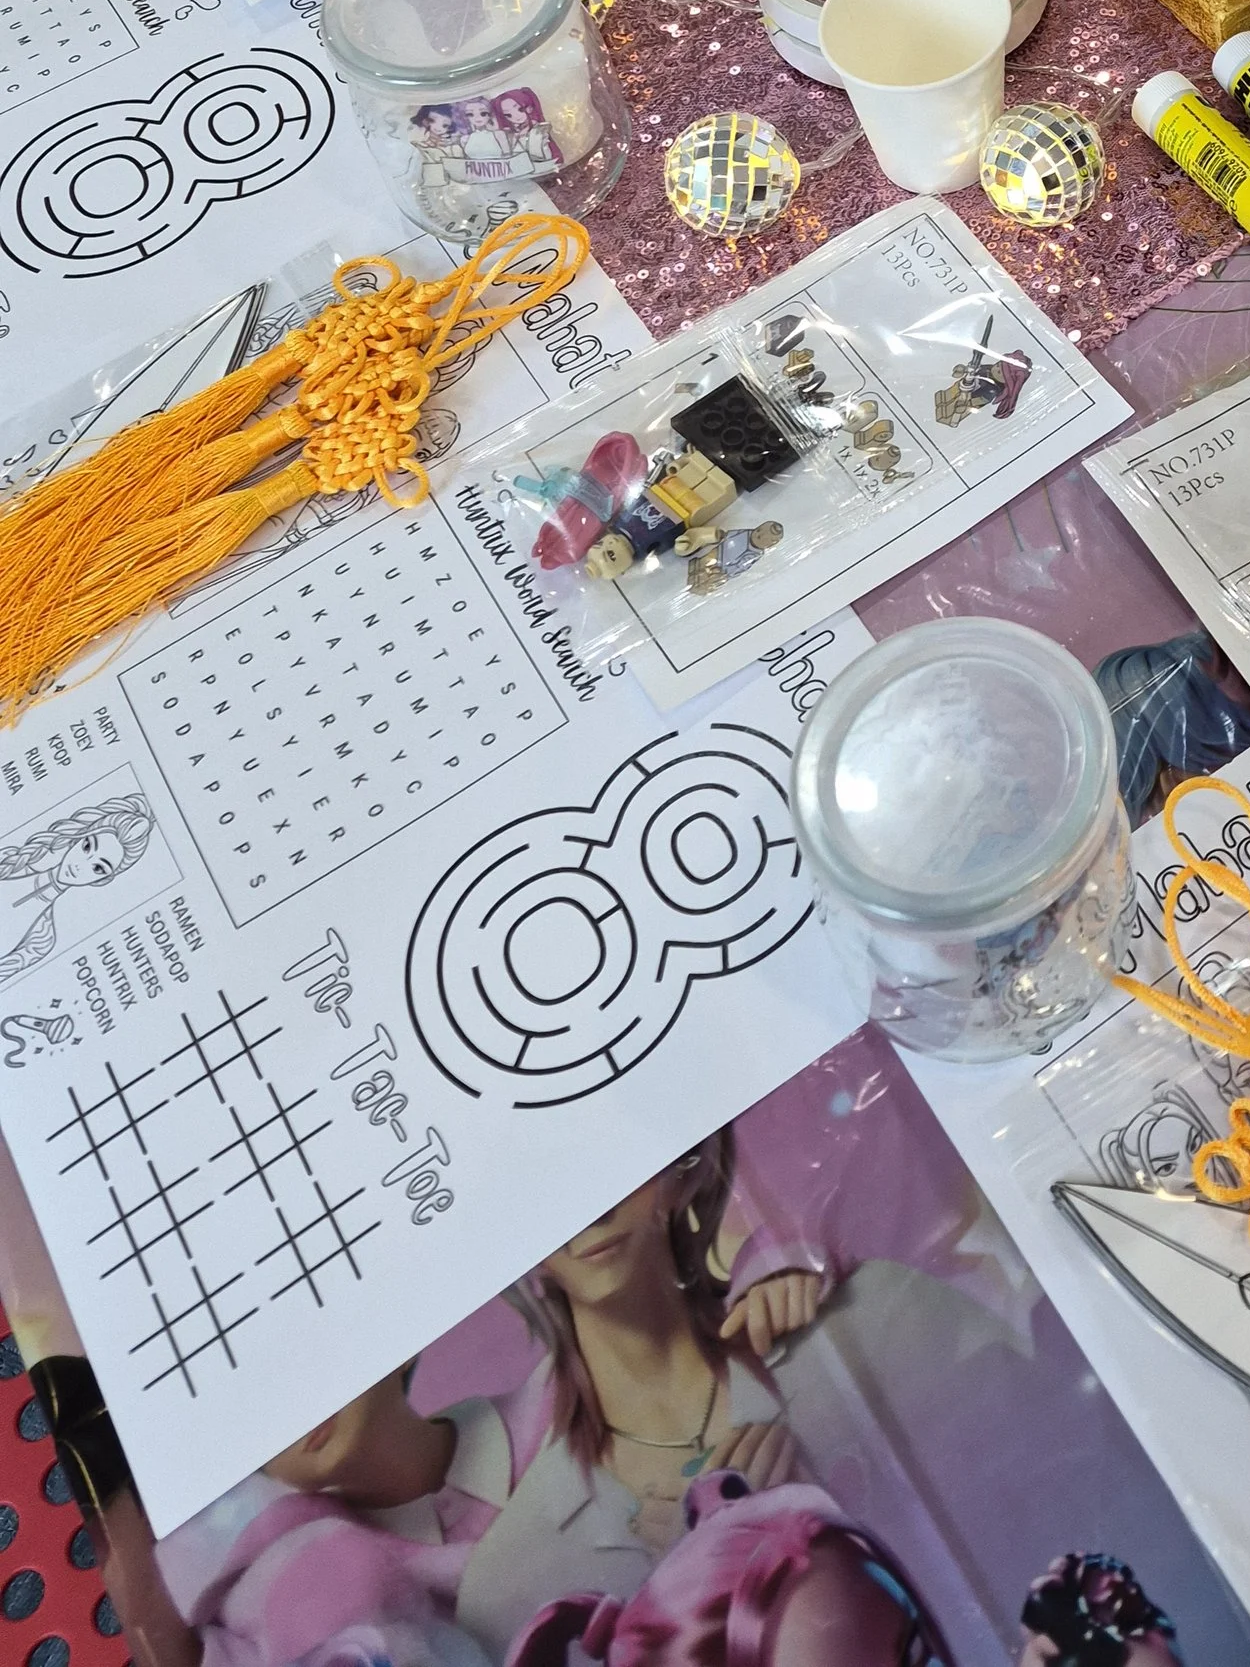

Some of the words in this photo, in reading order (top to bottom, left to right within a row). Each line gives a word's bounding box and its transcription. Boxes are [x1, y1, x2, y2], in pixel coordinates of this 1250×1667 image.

[465, 161, 513, 179] HUNTRIX
[881, 244, 920, 287] 13Pcs
[902, 227, 968, 294] NO.731P
[1148, 428, 1236, 485] NO.731P
[1168, 471, 1225, 507] 13Pcs
[455, 483, 516, 566] Huntrix
[504, 563, 559, 629] Word
[541, 625, 604, 702] Search
[47, 733, 73, 768] KPOP
[69, 719, 95, 753] ZOEY
[93, 706, 121, 746] PARTY
[1, 761, 24, 796] MIRA
[24, 747, 49, 782] RUMI
[145, 911, 190, 984] SODAPOP
[169, 896, 205, 952] RAMEN
[97, 940, 138, 1012] HUNTRIX
[121, 926, 164, 1000] HUNTERS
[72, 956, 116, 1036] POPCORN
